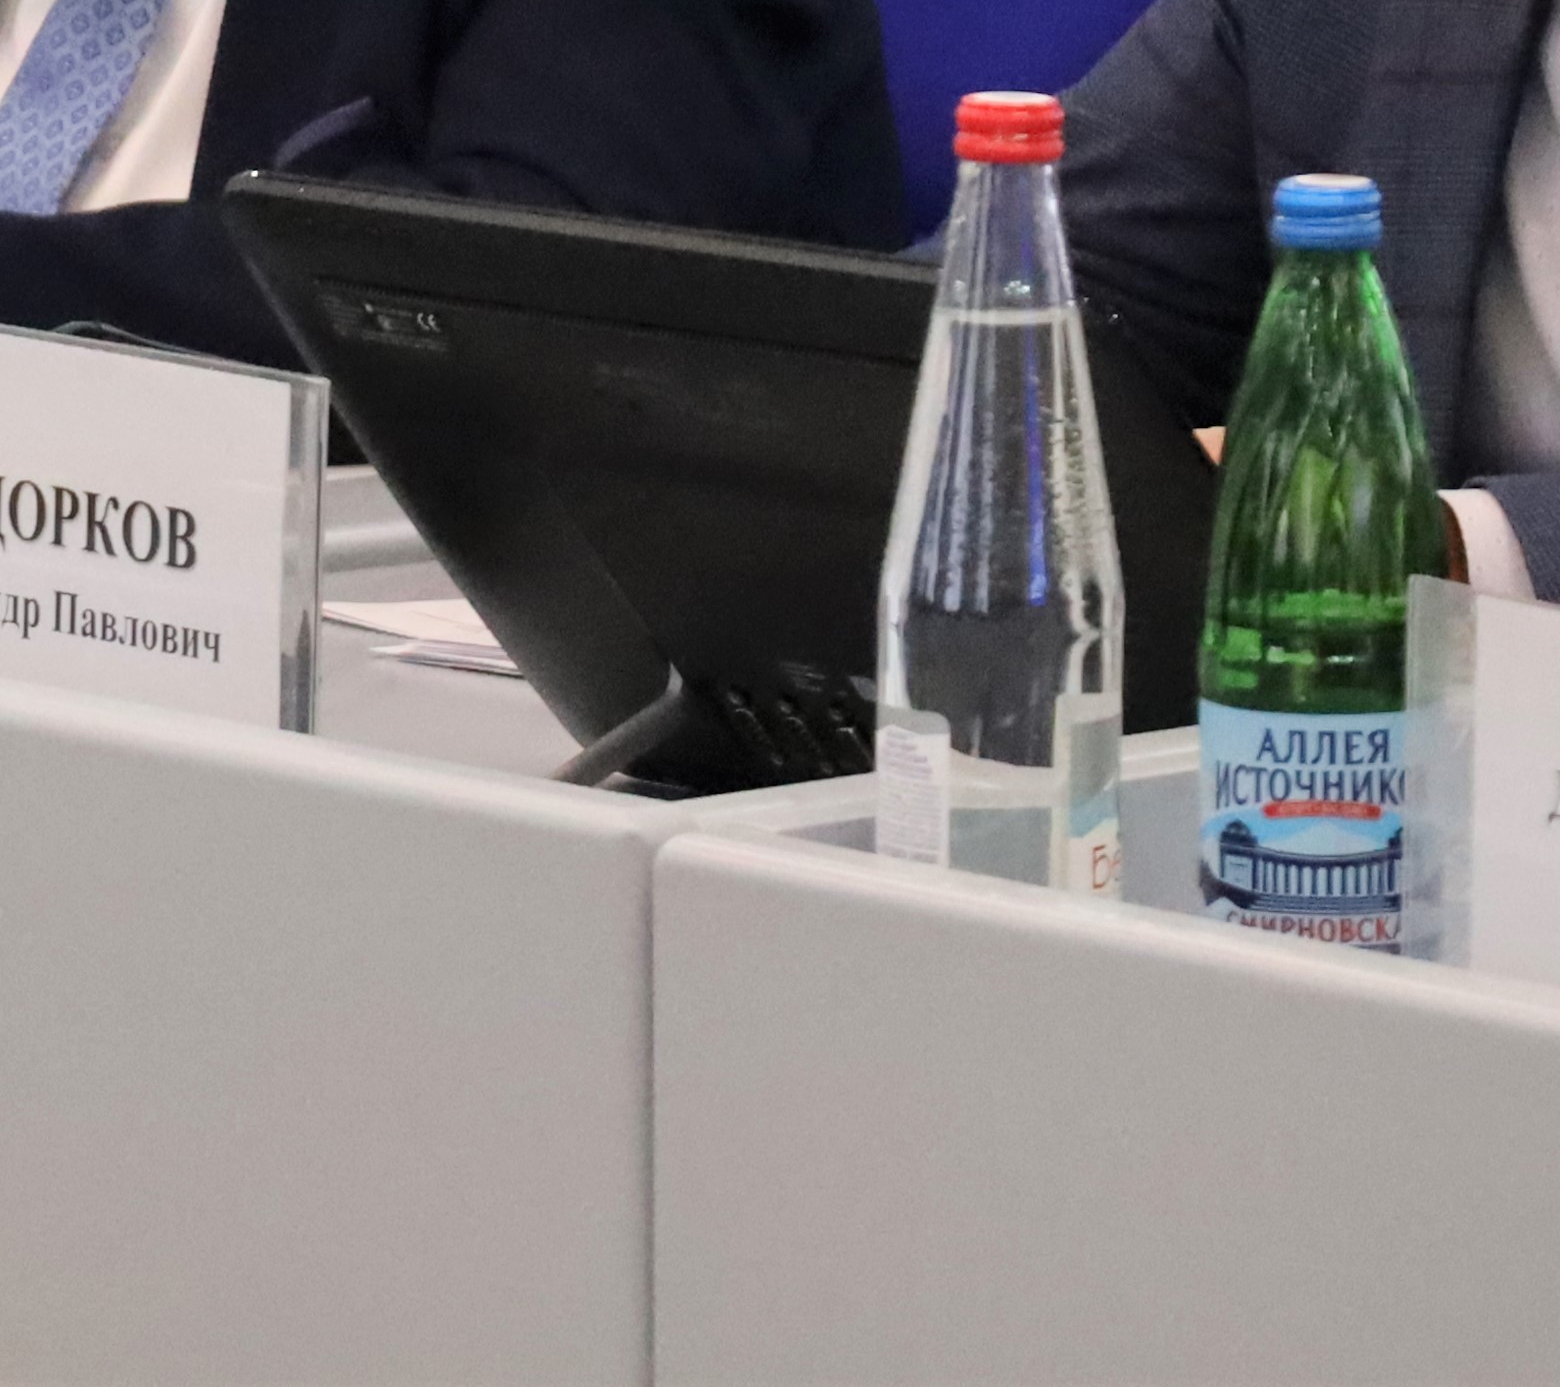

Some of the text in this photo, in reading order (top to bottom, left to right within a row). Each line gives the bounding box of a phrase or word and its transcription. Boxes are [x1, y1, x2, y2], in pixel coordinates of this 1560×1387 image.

[53, 590, 222, 663] Павлович
[1256, 728, 1390, 765] АЛЛЕЯ
[1215, 759, 1406, 810] ИСТОЧНИК
